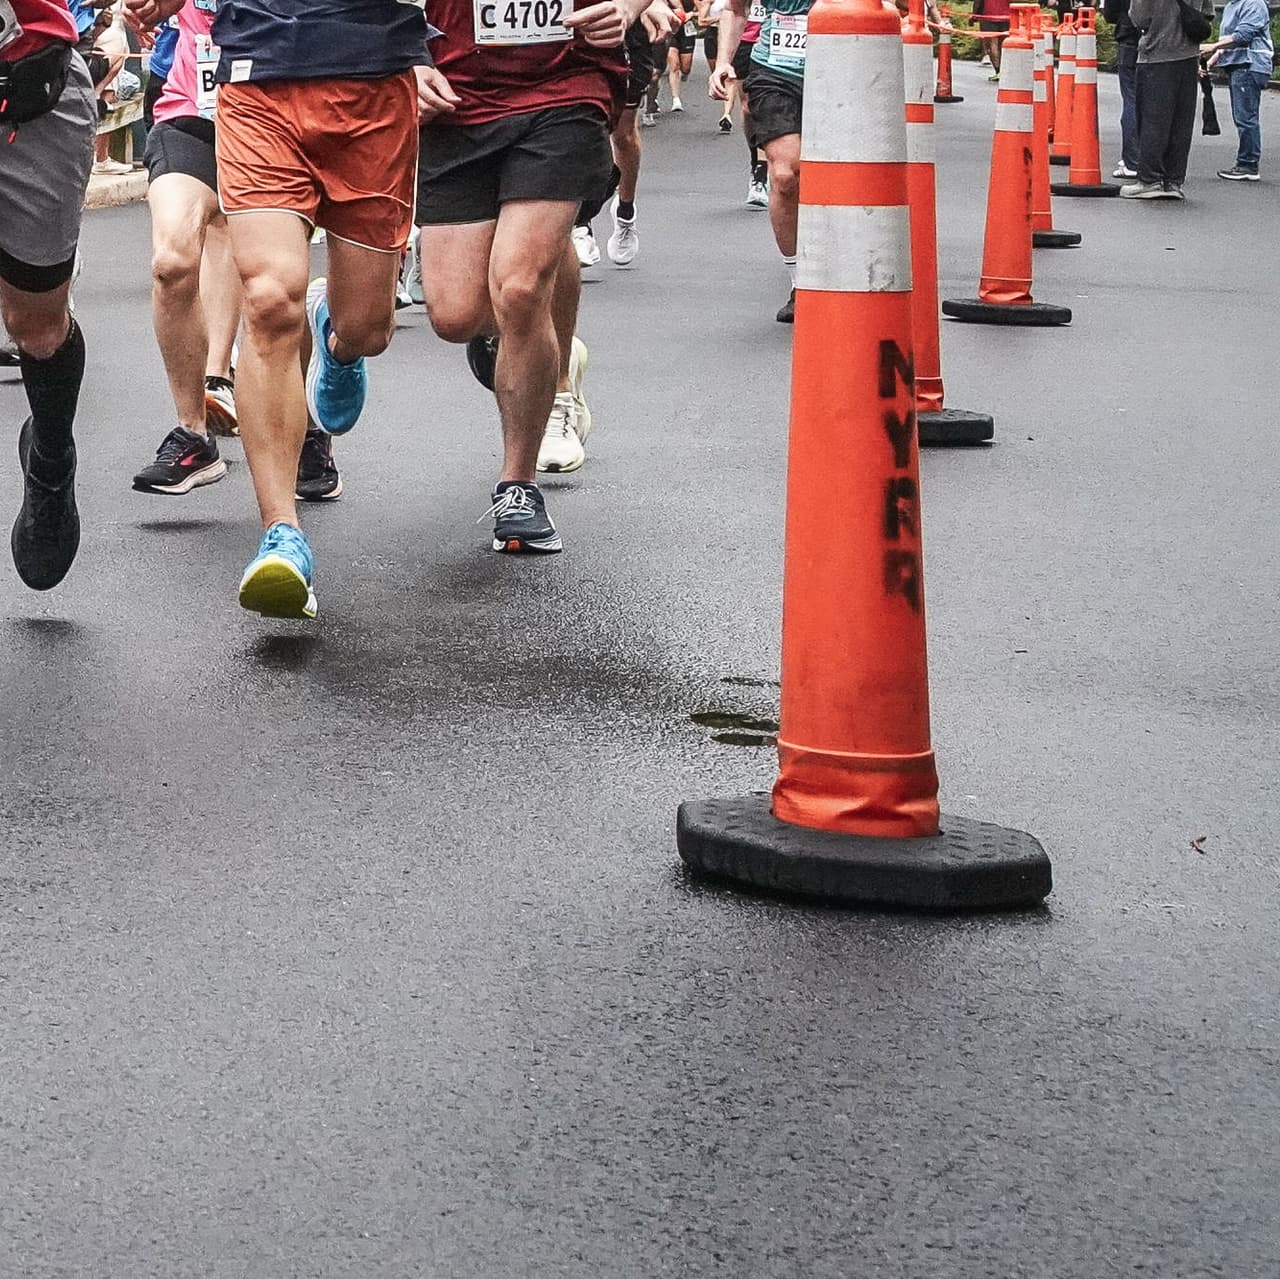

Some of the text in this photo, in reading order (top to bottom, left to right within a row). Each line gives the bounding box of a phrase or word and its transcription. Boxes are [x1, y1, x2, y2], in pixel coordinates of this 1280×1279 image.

[481, 0, 563, 29] C 4702
[773, 33, 781, 46] B
[202, 70, 216, 92] B
